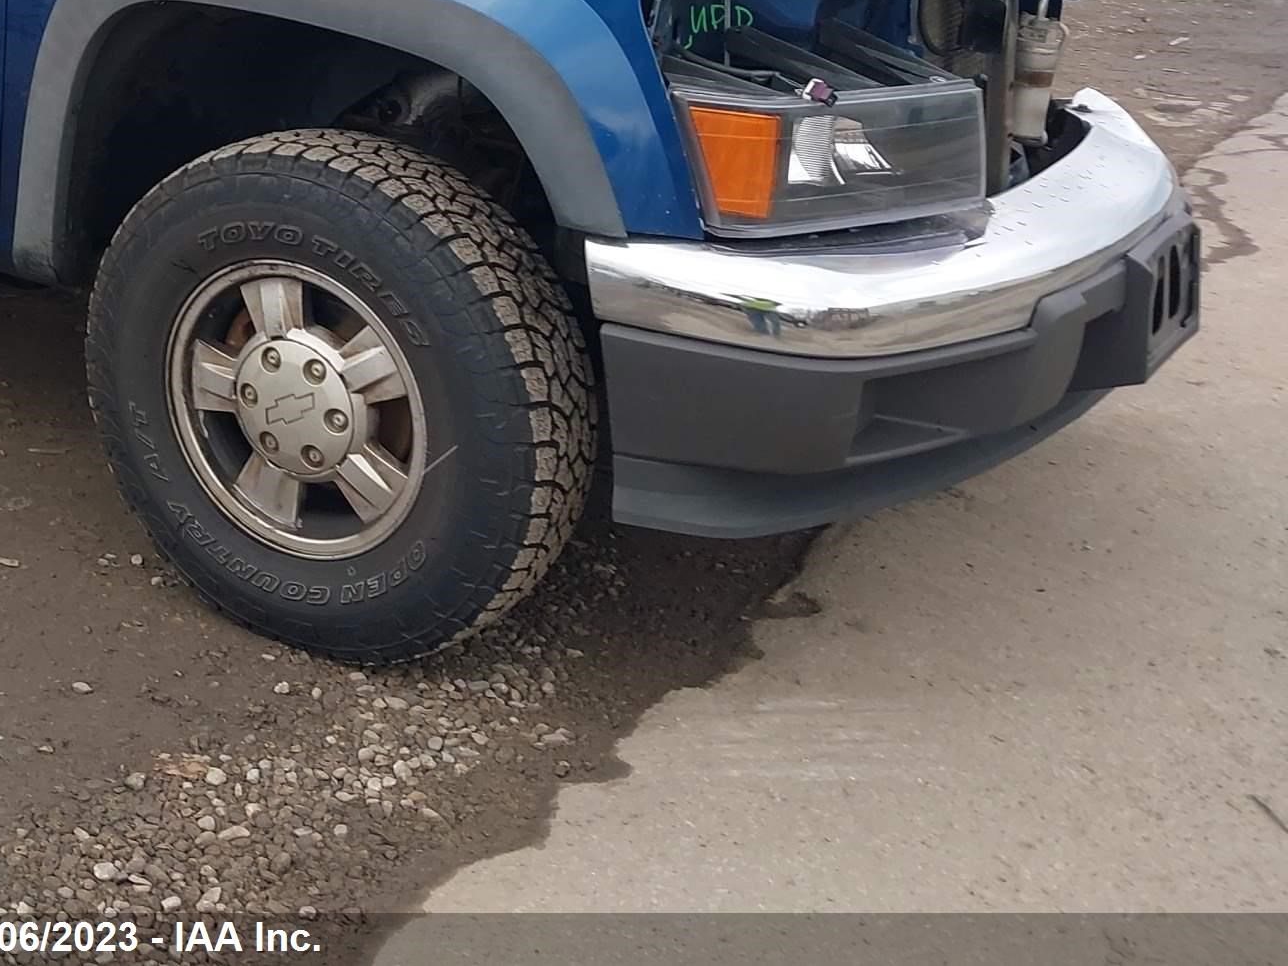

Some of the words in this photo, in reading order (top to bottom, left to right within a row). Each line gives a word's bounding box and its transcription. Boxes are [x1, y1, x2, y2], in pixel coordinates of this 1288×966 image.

[198, 221, 304, 251] TOYO
[312, 235, 431, 347] TIRES
[167, 500, 332, 605] COUNTRY
[340, 540, 427, 605] OPEN
